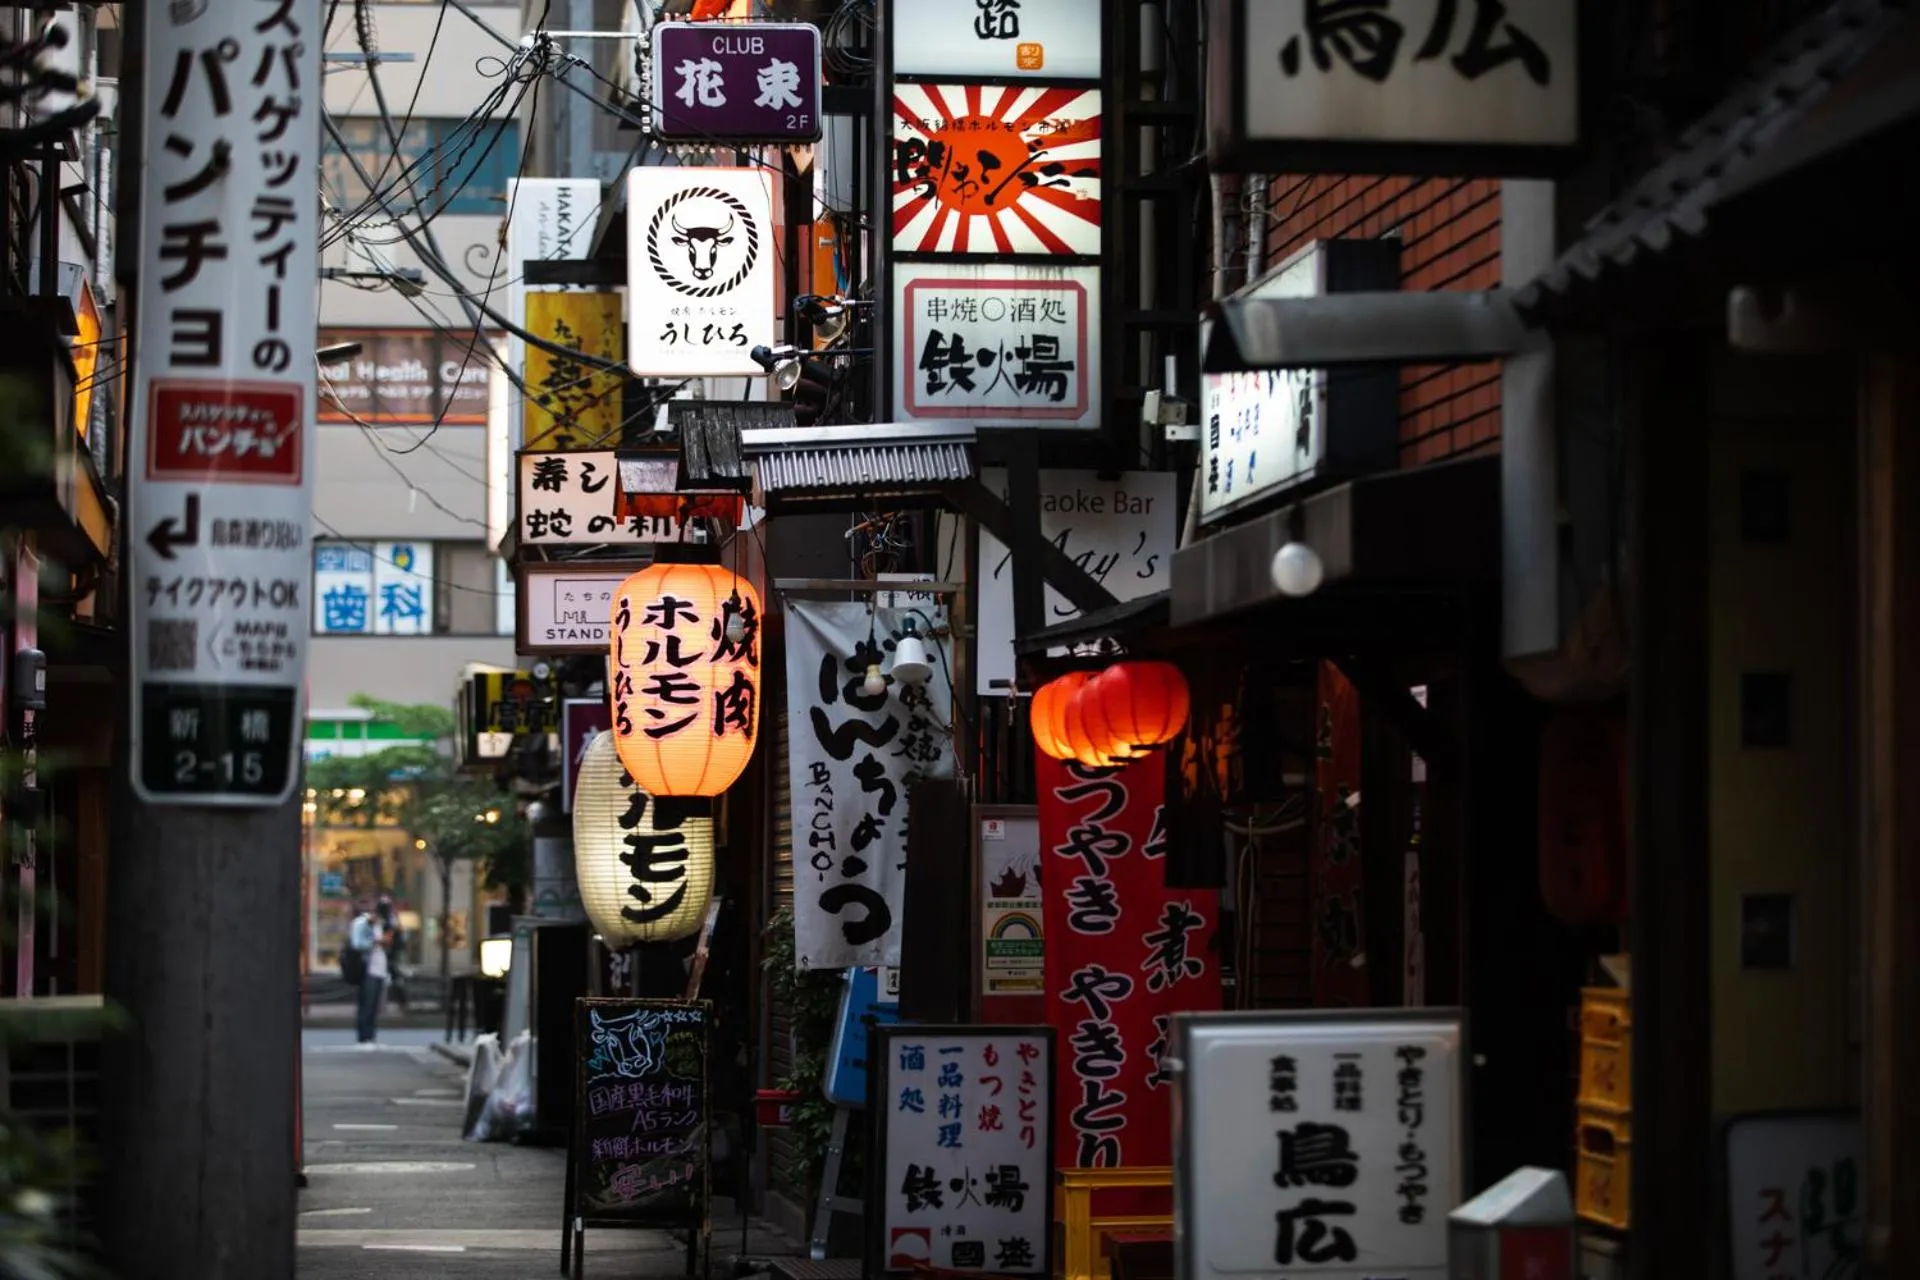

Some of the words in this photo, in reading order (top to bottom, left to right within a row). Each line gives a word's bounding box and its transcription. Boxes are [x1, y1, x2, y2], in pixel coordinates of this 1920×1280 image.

[712, 36, 765, 55] CLUB
[786, 115, 808, 129] 2F
[159, 37, 240, 368] パンチョ
[557, 187, 572, 260] HAKATA
[660, 321, 748, 346] うしひろ
[919, 328, 1074, 401] 鉄火場
[531, 456, 609, 494] 寿し
[1003, 488, 1104, 514] aoke
[1113, 490, 1155, 515] Bar
[323, 583, 425, 631] 歯科
[546, 628, 604, 640] STAND
[615, 598, 634, 736] うしひろ
[641, 595, 703, 739] ホルモン
[710, 595, 758, 740] 焼肉
[169, 707, 271, 742] 新橋
[175, 754, 264, 785] 2-15
[810, 640, 900, 946] ばんちょう
[617, 754, 690, 924] ルモン
[899, 1045, 925, 1114] 酒処
[937, 1046, 964, 1149] 一品料理
[978, 1043, 1003, 1132] もつ焼
[1016, 1042, 1040, 1150] やきとり
[1060, 963, 1134, 1168] やきとり
[901, 1163, 1030, 1213] 鉄火場
[1273, 1121, 1360, 1265] 鳥広
[1758, 1188, 1795, 1280] スナ
